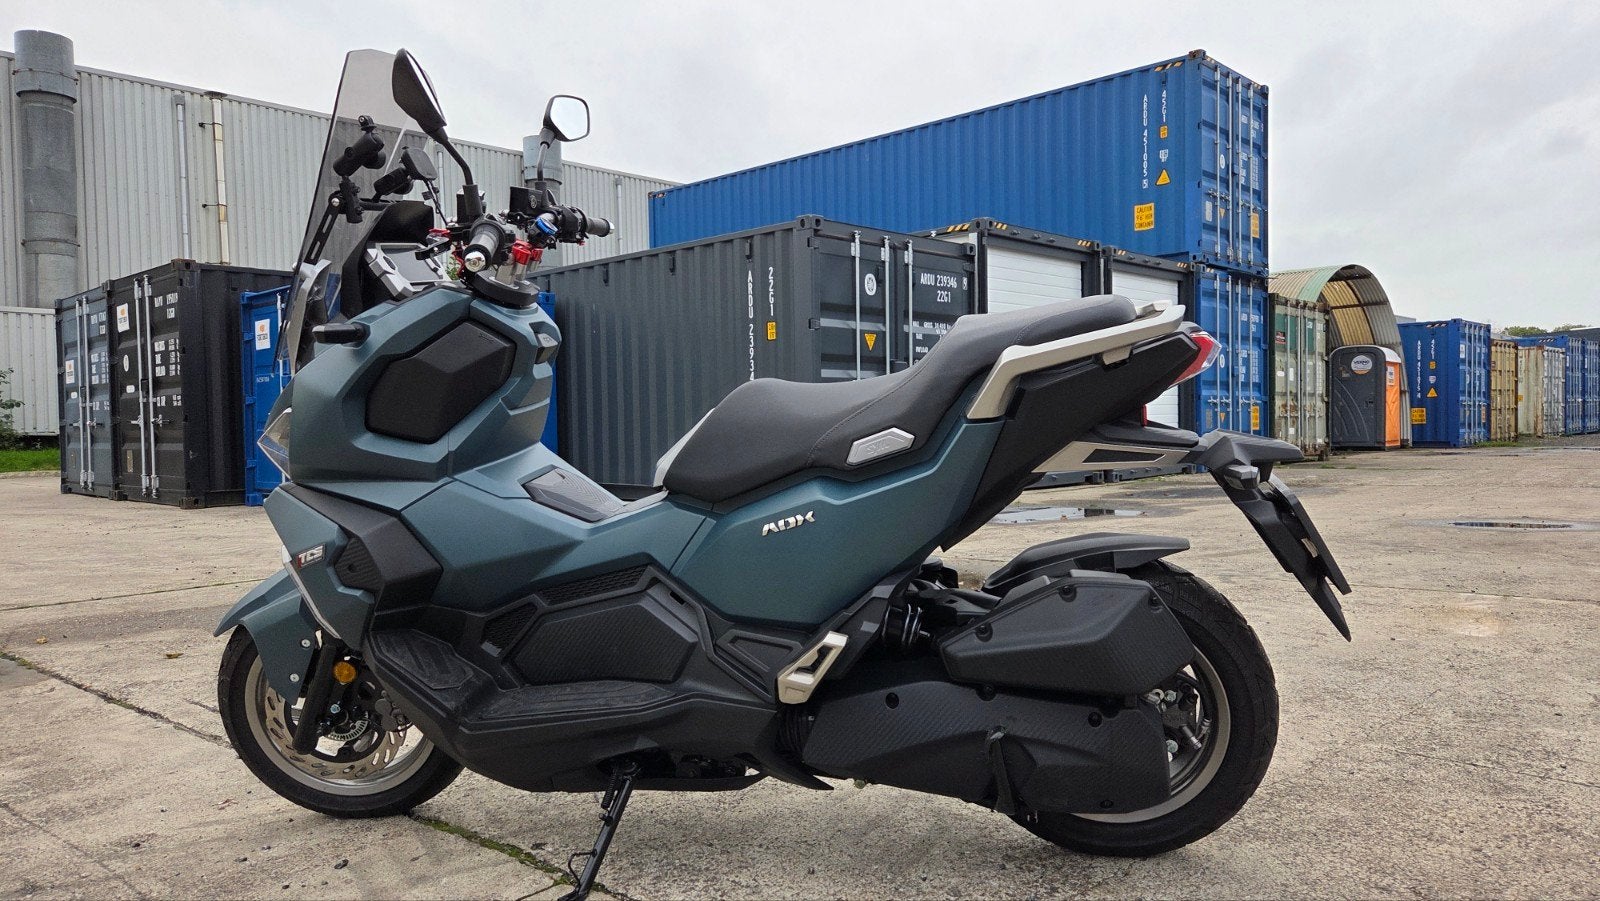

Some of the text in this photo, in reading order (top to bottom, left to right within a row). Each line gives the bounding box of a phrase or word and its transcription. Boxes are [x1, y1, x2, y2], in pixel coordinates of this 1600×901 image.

[920, 272, 935, 286] ARDU
[936, 275, 957, 289] 239346
[937, 290, 951, 303] 22G1
[762, 510, 816, 537] ADX
[298, 545, 323, 564] TCS
